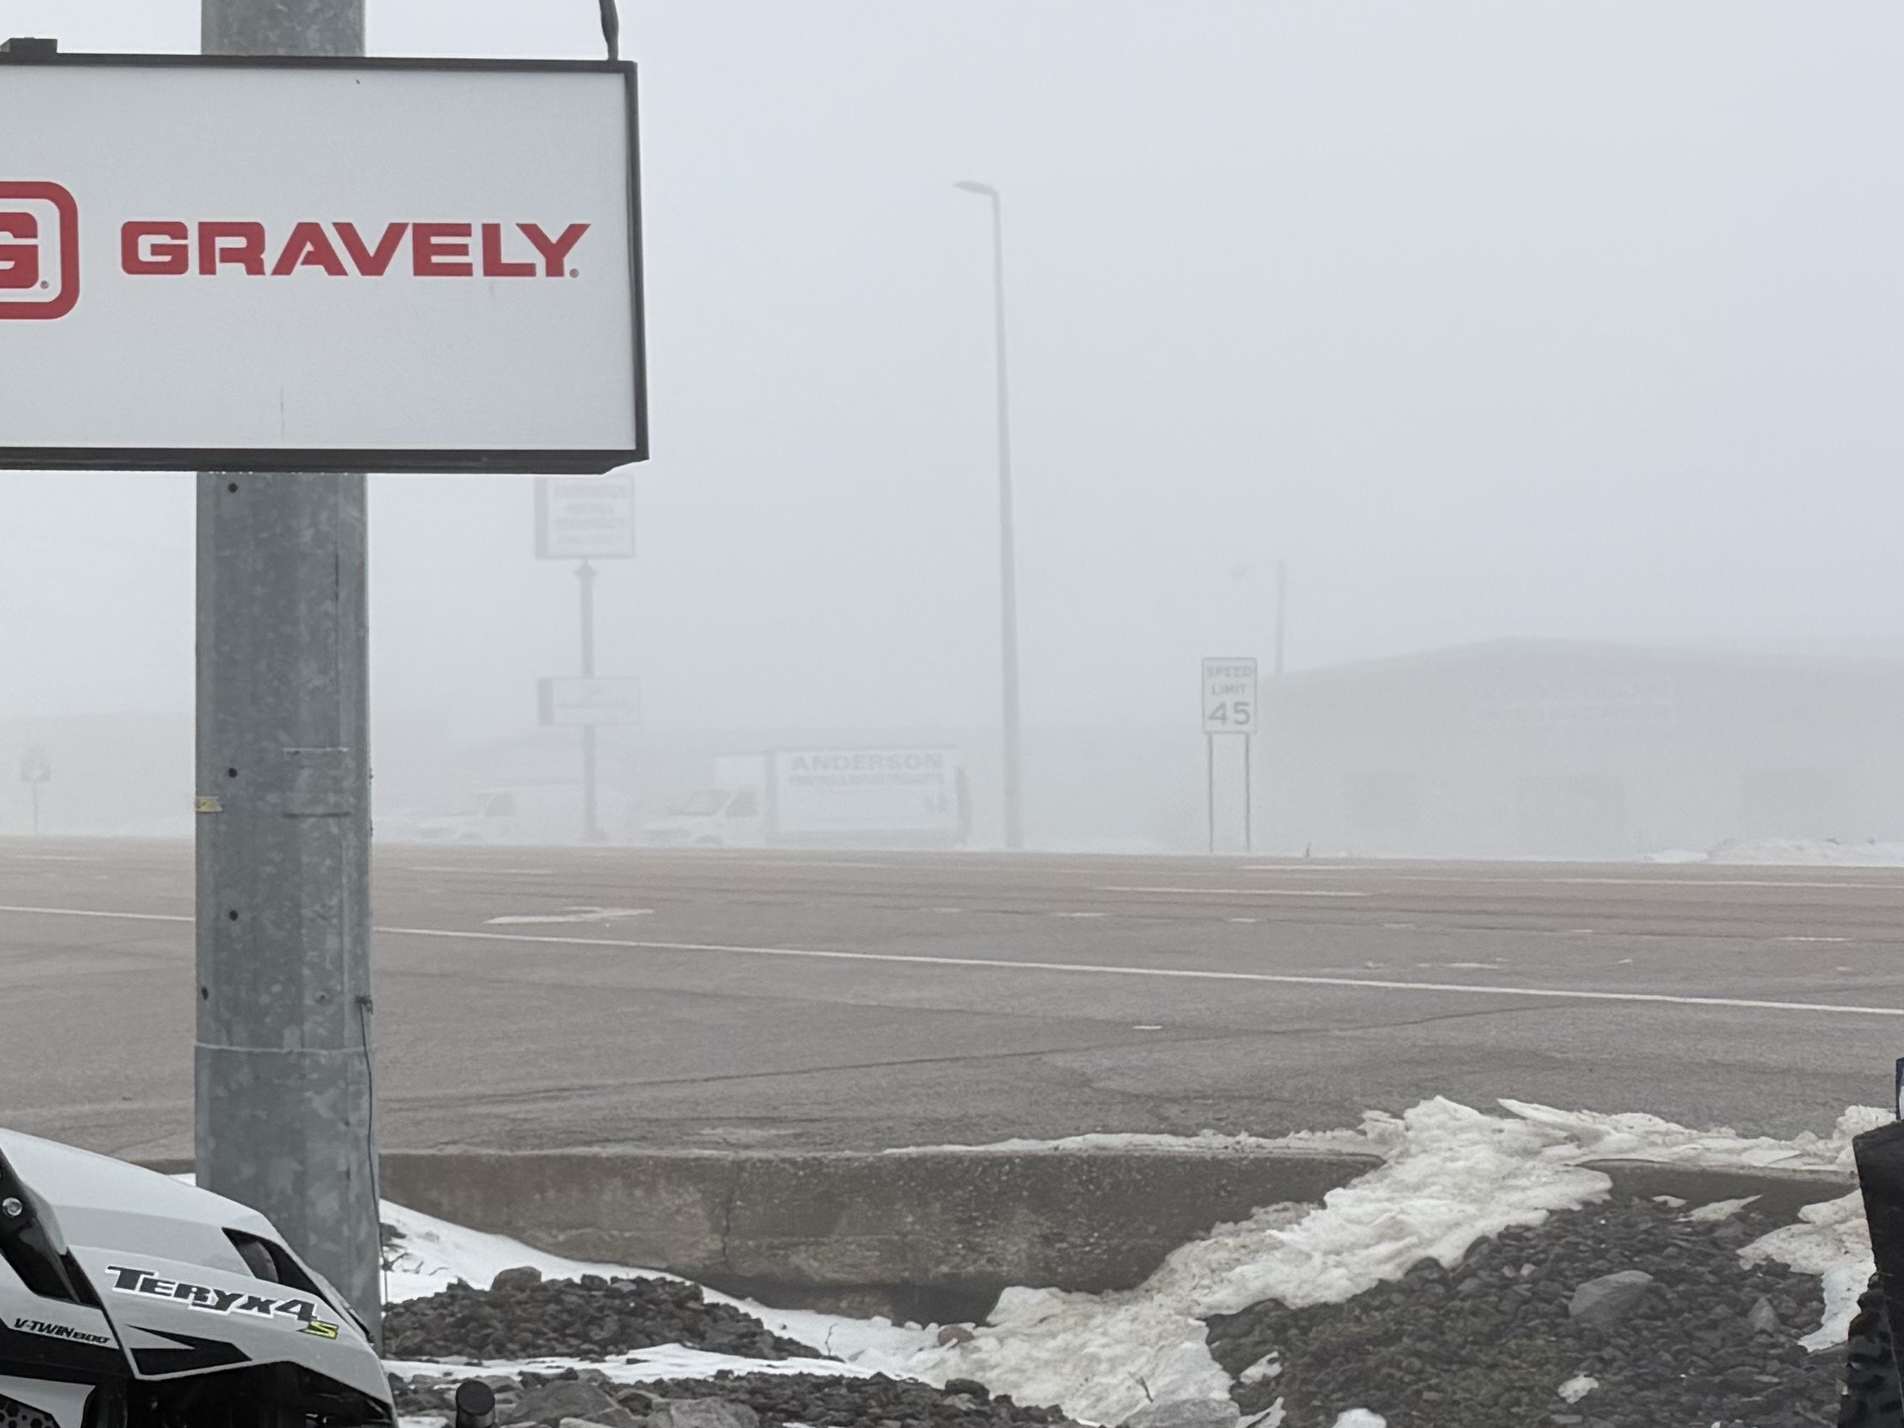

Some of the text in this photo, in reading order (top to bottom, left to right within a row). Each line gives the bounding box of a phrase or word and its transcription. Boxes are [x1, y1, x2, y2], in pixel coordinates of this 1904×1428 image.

[121, 221, 591, 278] GRAVELY
[1207, 665, 1253, 678] SPEED
[1211, 683, 1247, 696] LIMIT
[1208, 700, 1252, 726] 45
[791, 752, 944, 771] ANDERSON
